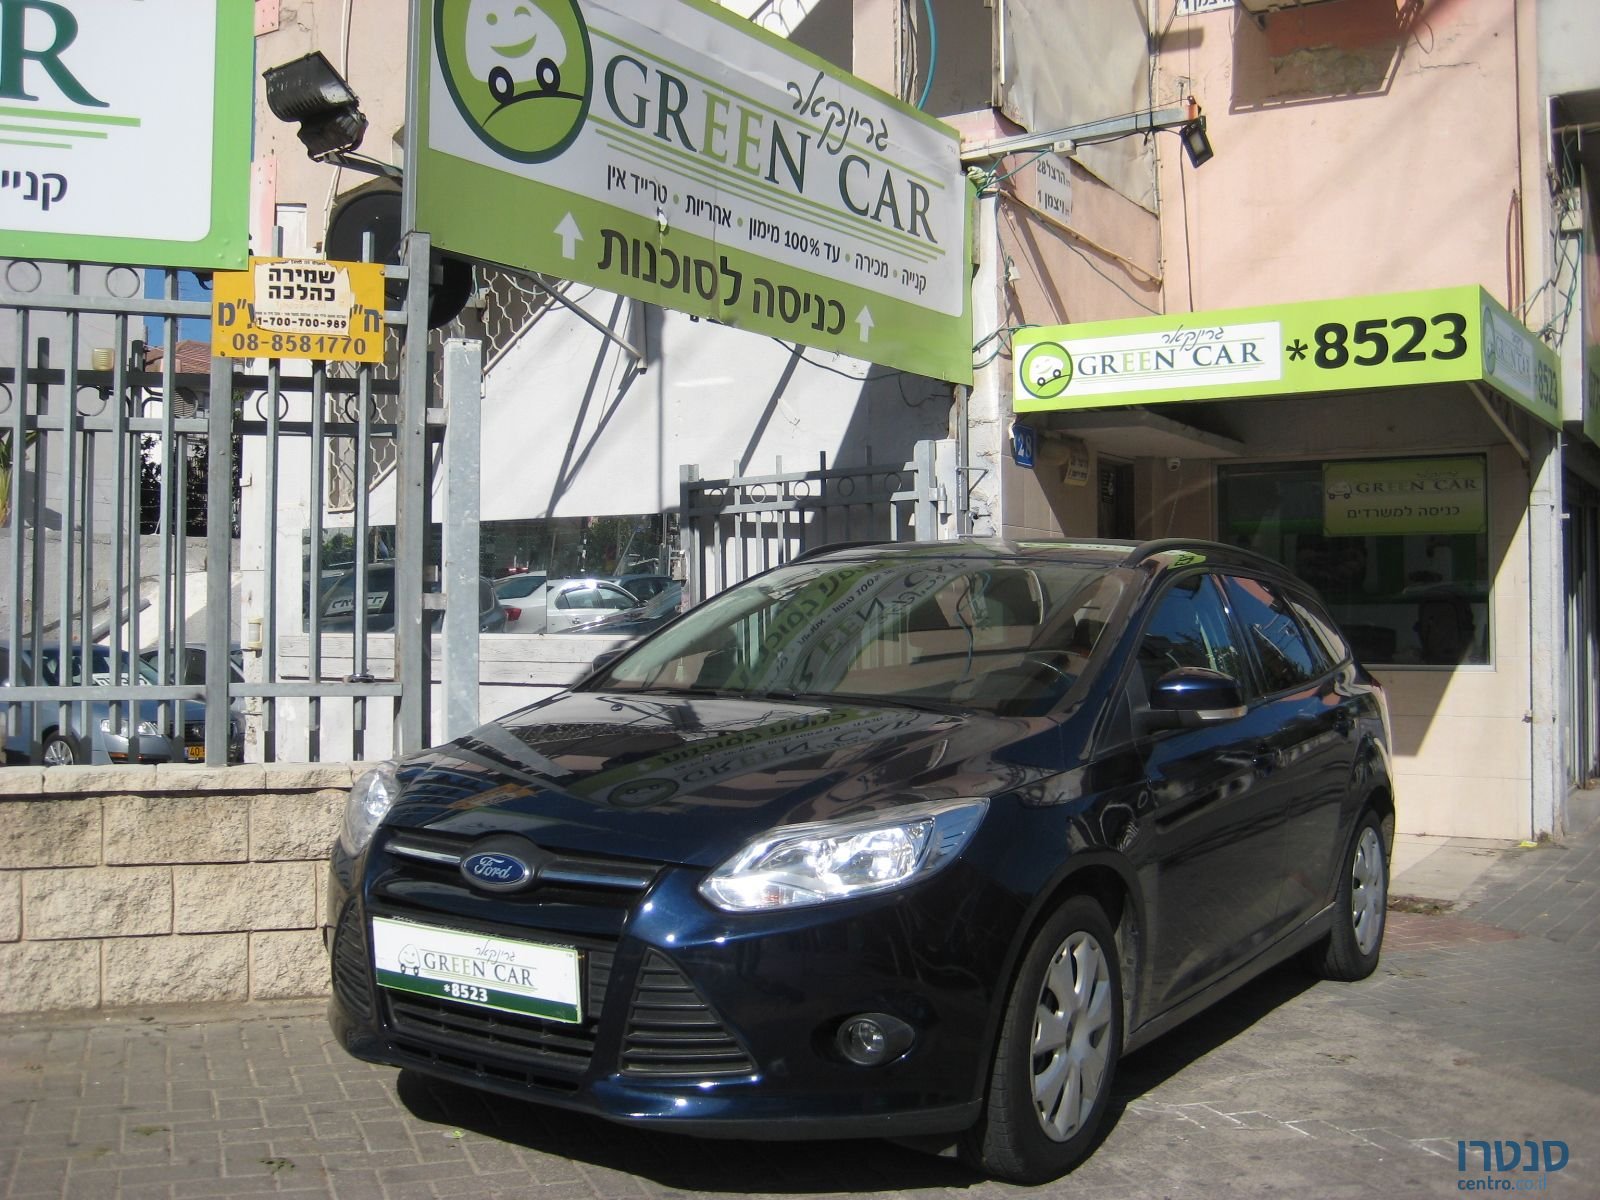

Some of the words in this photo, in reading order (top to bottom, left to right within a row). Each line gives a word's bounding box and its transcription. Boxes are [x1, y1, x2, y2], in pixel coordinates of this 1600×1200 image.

[604, 54, 812, 194] GREEN
[838, 154, 938, 244] CAR
[607, 164, 627, 191] אין
[630, 172, 668, 204] טרייד
[684, 195, 732, 228] אחריות
[749, 217, 780, 244] מימון
[784, 230, 820, 257] 100%
[823, 242, 841, 263] עד
[855, 252, 889, 278] מכירה
[268, 267, 336, 284] שמירה
[597, 228, 743, 306] לסוכנות
[268, 284, 336, 302] כהלכה
[901, 268, 927, 295] קנייה
[752, 277, 846, 335] כניסה
[257, 317, 347, 329] 1-700-700-989
[232, 332, 366, 355] 08-8581770
[1077, 348, 1175, 376] GREEN
[1191, 341, 1263, 367] CAR
[1434, 478, 1477, 490] CAR
[1346, 505, 1413, 519] למשרדים
[1418, 505, 1460, 517] כניסה
[474, 856, 513, 879] Ford
[423, 952, 486, 978] GREEN
[494, 964, 534, 987] CAR
